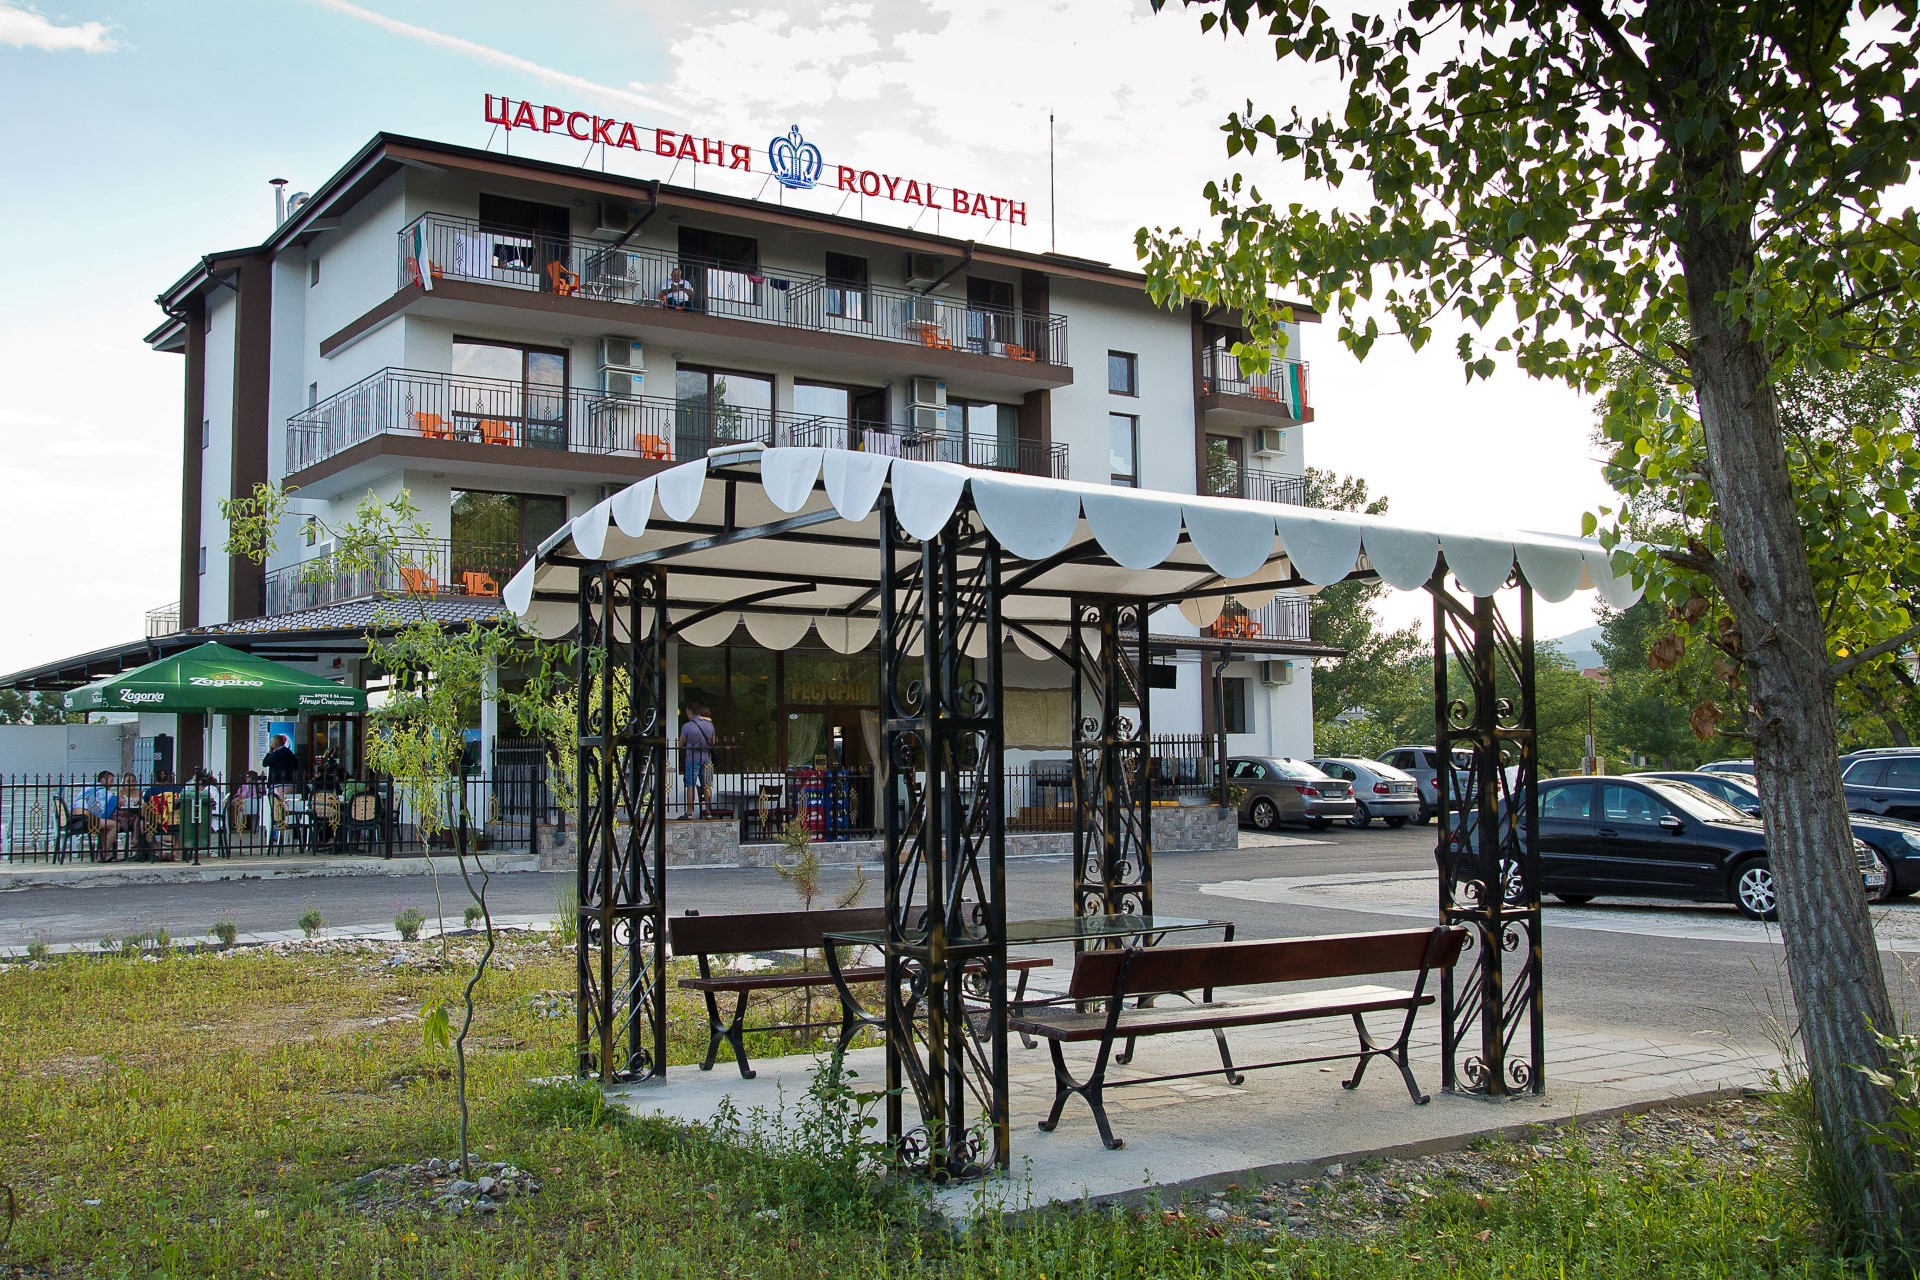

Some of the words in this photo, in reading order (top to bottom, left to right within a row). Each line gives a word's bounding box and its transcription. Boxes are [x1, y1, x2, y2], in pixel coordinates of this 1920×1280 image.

[485, 93, 640, 151] ЦАРСКА
[656, 128, 751, 172] БАНЯ
[838, 165, 942, 210] ROYAL
[953, 188, 1027, 226] BATH
[120, 688, 165, 704] Zagorka
[189, 676, 264, 687] Zagorka
